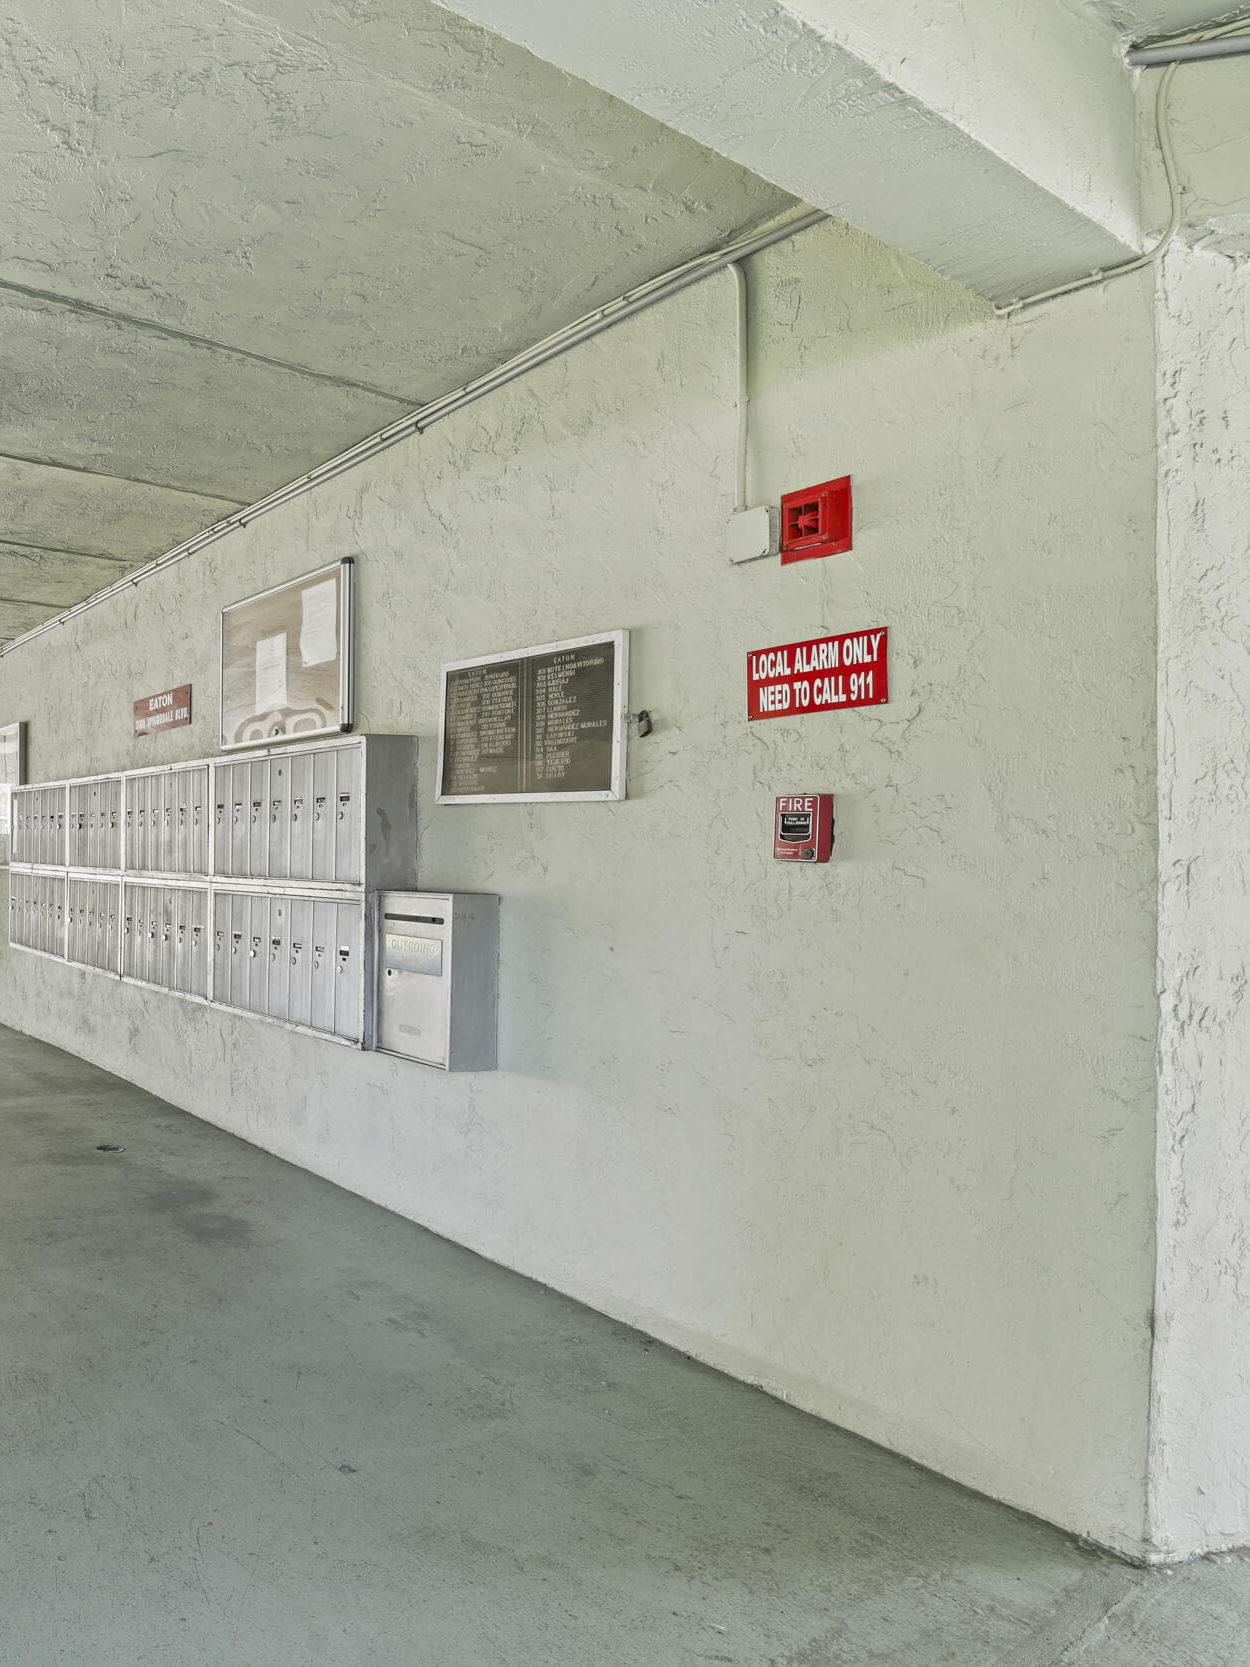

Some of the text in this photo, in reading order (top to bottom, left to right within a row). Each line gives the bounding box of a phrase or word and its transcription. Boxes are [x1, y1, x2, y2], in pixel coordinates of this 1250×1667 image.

[553, 654, 575, 664] EATON
[752, 633, 882, 680] LOCAL ALARM ONLY
[759, 670, 873, 713] NEED TO CALL 911
[149, 693, 173, 711] EATON
[779, 798, 813, 811] FIRE
[391, 939, 436, 954] OUTGOING
